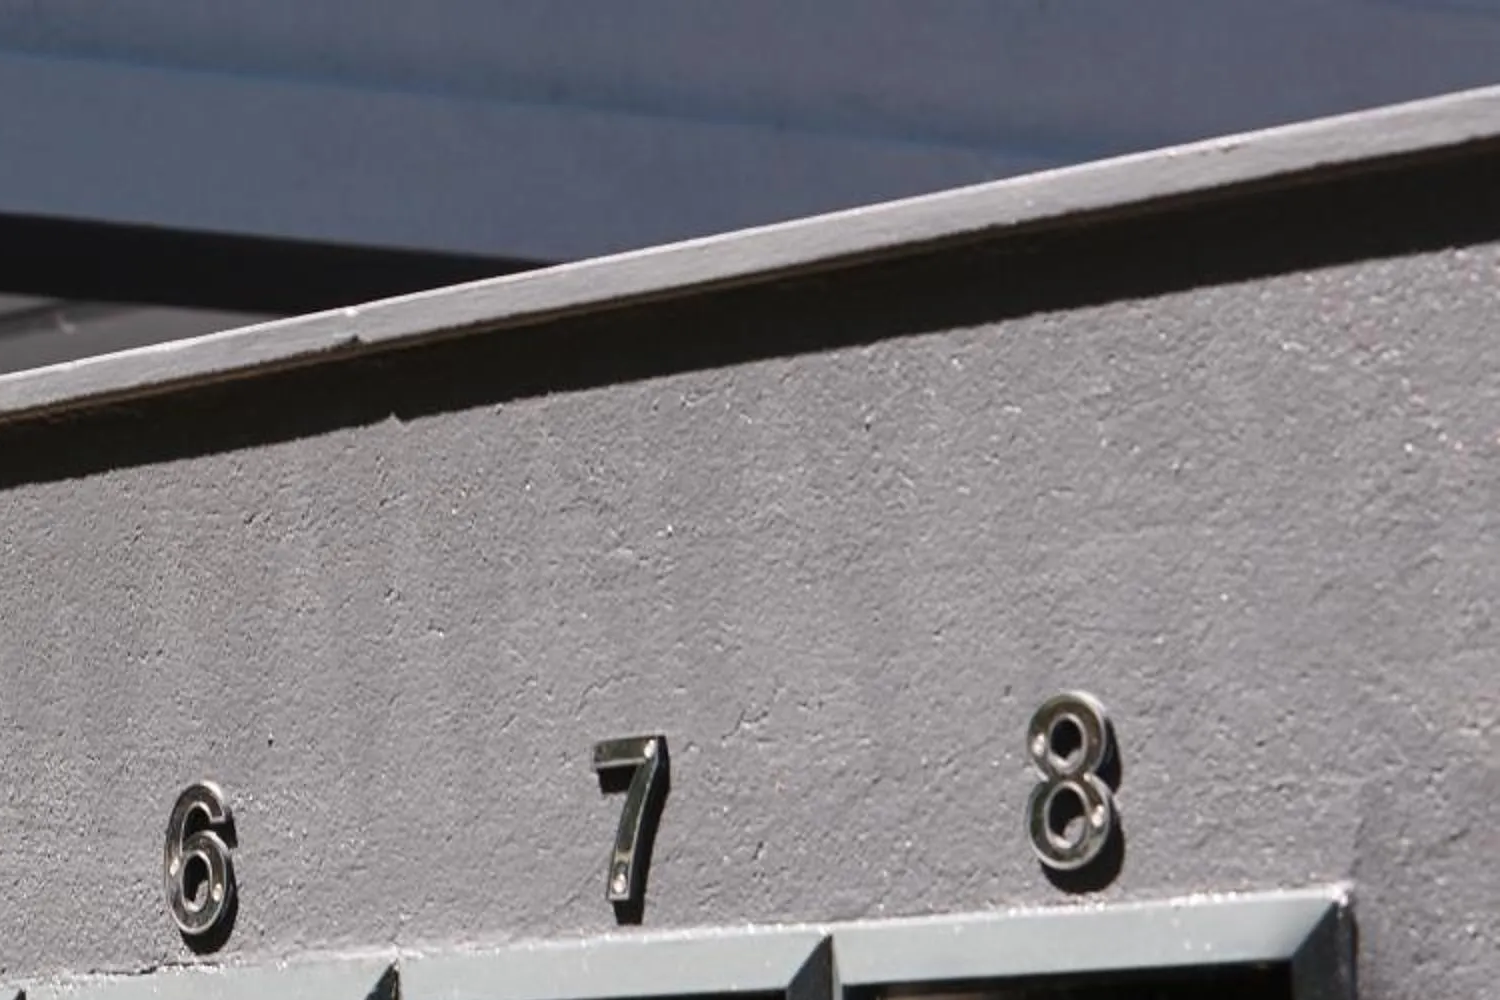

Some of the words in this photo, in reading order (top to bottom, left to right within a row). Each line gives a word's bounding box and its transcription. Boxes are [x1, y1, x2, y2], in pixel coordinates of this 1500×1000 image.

[163, 783, 234, 935] 6
[593, 734, 668, 902] 7
[1026, 690, 1112, 871] 8
